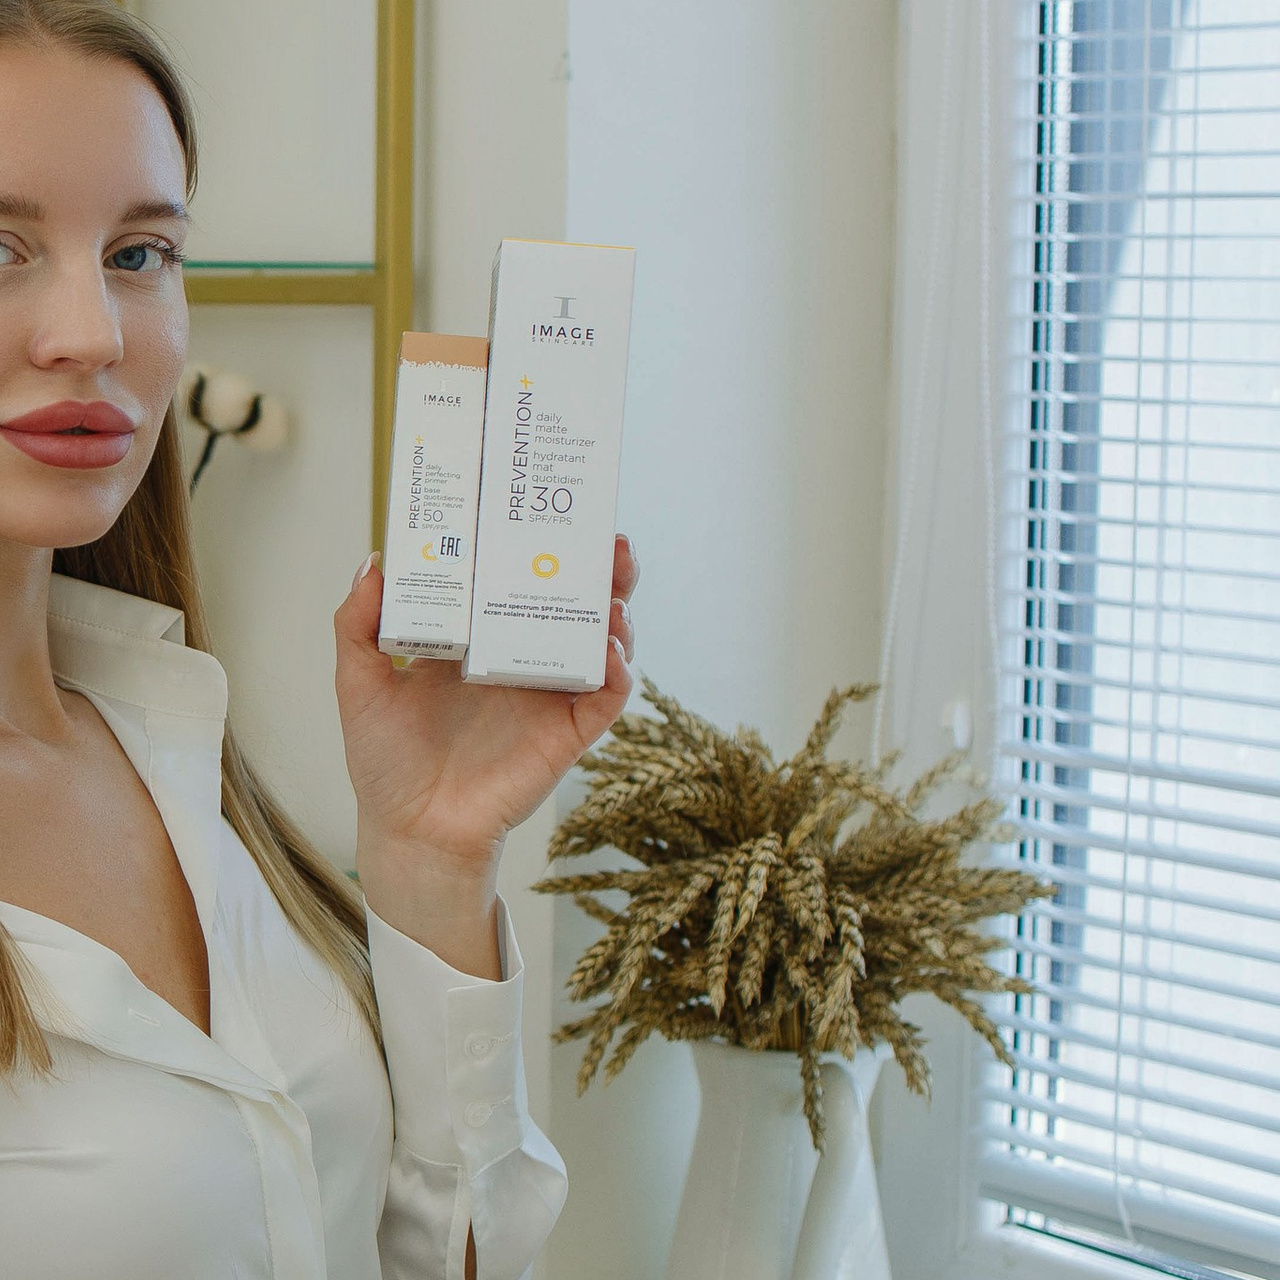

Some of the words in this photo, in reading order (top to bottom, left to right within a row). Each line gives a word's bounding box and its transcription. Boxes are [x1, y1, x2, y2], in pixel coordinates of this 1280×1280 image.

[531, 324, 595, 340] IMAGE
[531, 337, 594, 347] SKINCARE
[423, 394, 461, 404] IMAGE
[536, 412, 562, 424] daily
[535, 424, 568, 434] matte
[534, 435, 596, 447] moisturizer
[533, 450, 587, 464] hydratant
[425, 464, 442, 472] daily
[532, 463, 554, 472] mat
[425, 470, 461, 479] perfecting
[531, 474, 584, 486] quotidien
[423, 494, 465, 503] quotidienne
[530, 486, 573, 514] 30
[423, 509, 443, 522] 50
[528, 514, 573, 526] SPF/FPS
[508, 592, 528, 600] digital
[530, 594, 548, 602] aging
[508, 603, 539, 611] spectrum
[565, 608, 598, 616] sunscreen
[532, 612, 549, 620] large
